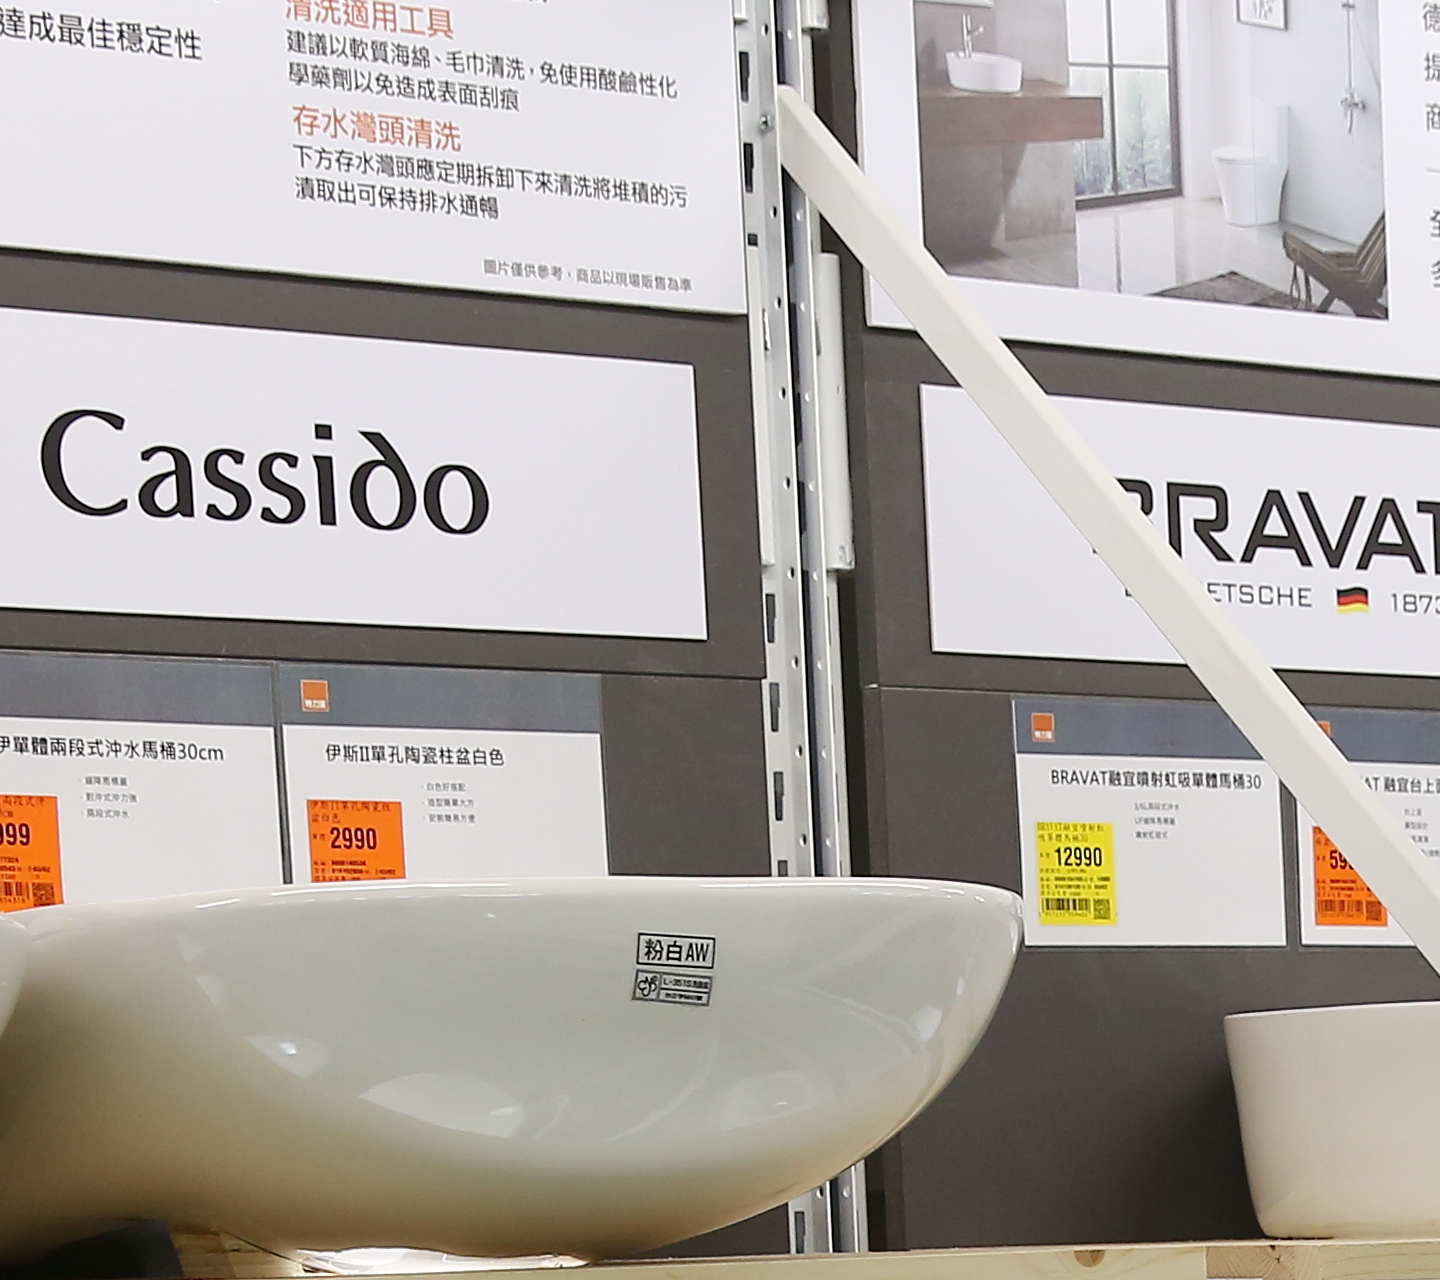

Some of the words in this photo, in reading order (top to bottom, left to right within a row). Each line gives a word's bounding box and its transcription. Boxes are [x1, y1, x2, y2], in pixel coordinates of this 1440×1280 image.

[284, 0, 456, 40] 清洗適用工具
[288, 62, 521, 113] 學藥劑以免造成表面刮痕
[291, 104, 463, 153] 存水灣頭清洗
[39, 407, 491, 536] Cassido
[330, 827, 378, 851] 2990
[1054, 846, 1103, 867] 12990
[1329, 849, 1356, 870] 59
